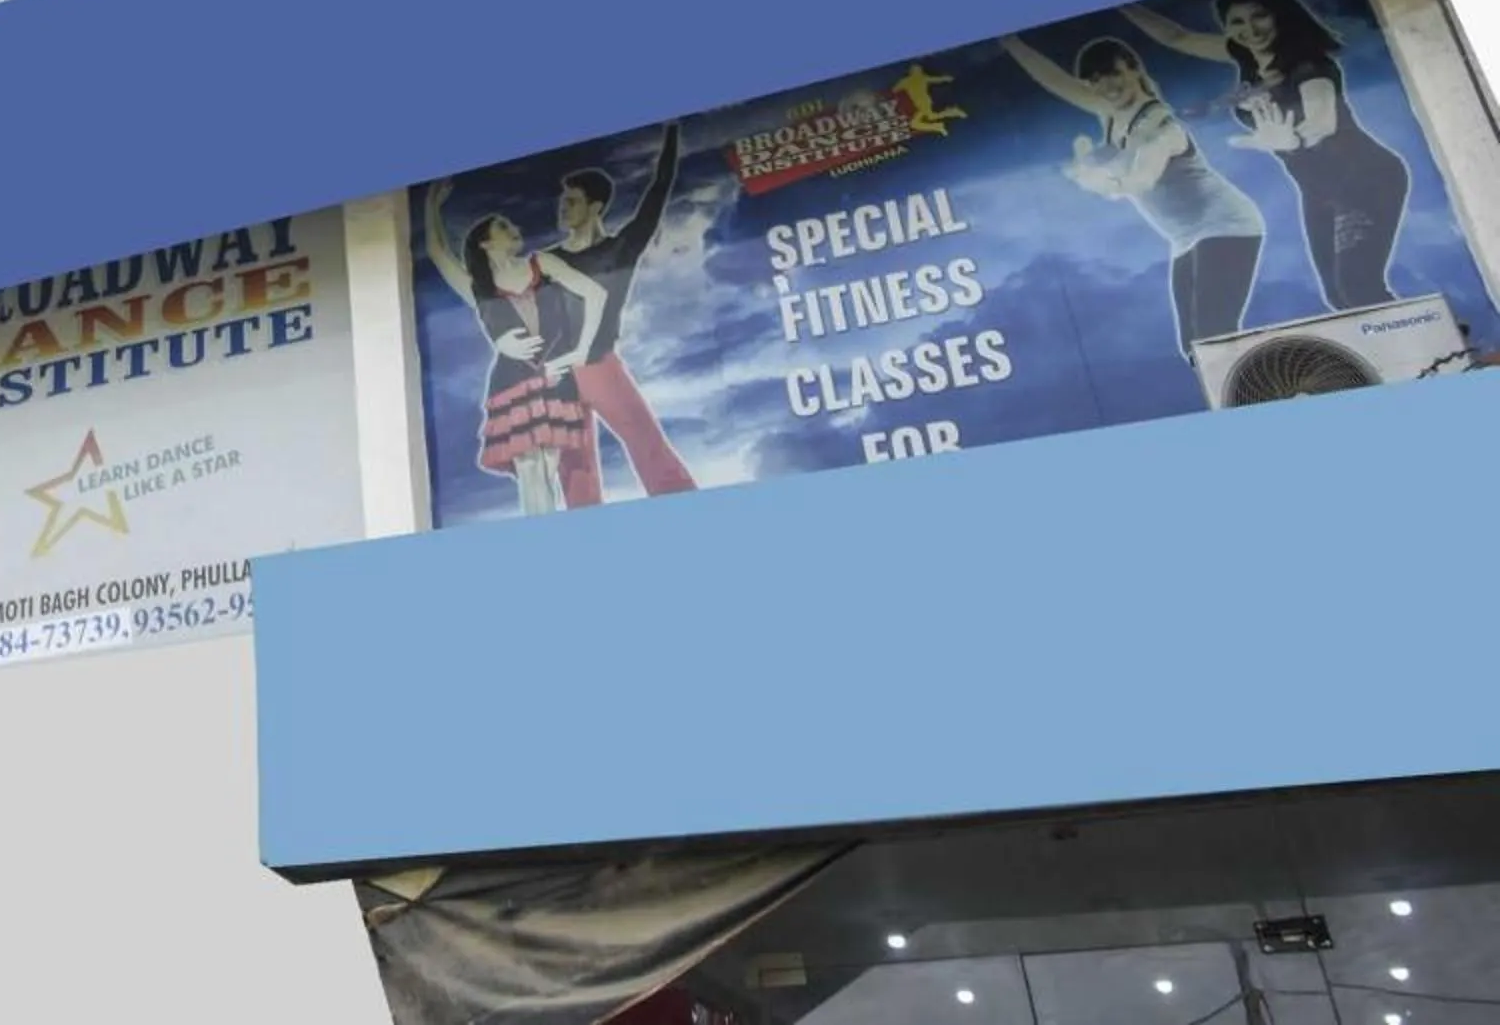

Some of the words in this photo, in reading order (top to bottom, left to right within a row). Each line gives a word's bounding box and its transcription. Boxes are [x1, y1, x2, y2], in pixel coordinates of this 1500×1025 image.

[734, 98, 900, 156] BROADWAY
[738, 114, 911, 166] DANCE
[739, 126, 913, 179] INSTITUTE
[827, 144, 910, 179] LUDHIANA
[766, 187, 969, 271] SPECIAL
[778, 257, 985, 343] FITNESS
[1360, 309, 1443, 336] Panasonic
[786, 329, 1013, 417] CLASSES
[77, 459, 141, 494] LEARN
[146, 435, 216, 472] DANCE
[861, 420, 962, 465] FOR
[123, 473, 166, 502] LIKE
[171, 467, 187, 487] A
[191, 449, 242, 480] STAR
[39, 586, 90, 616] BAGH
[95, 572, 177, 606] COLONY,
